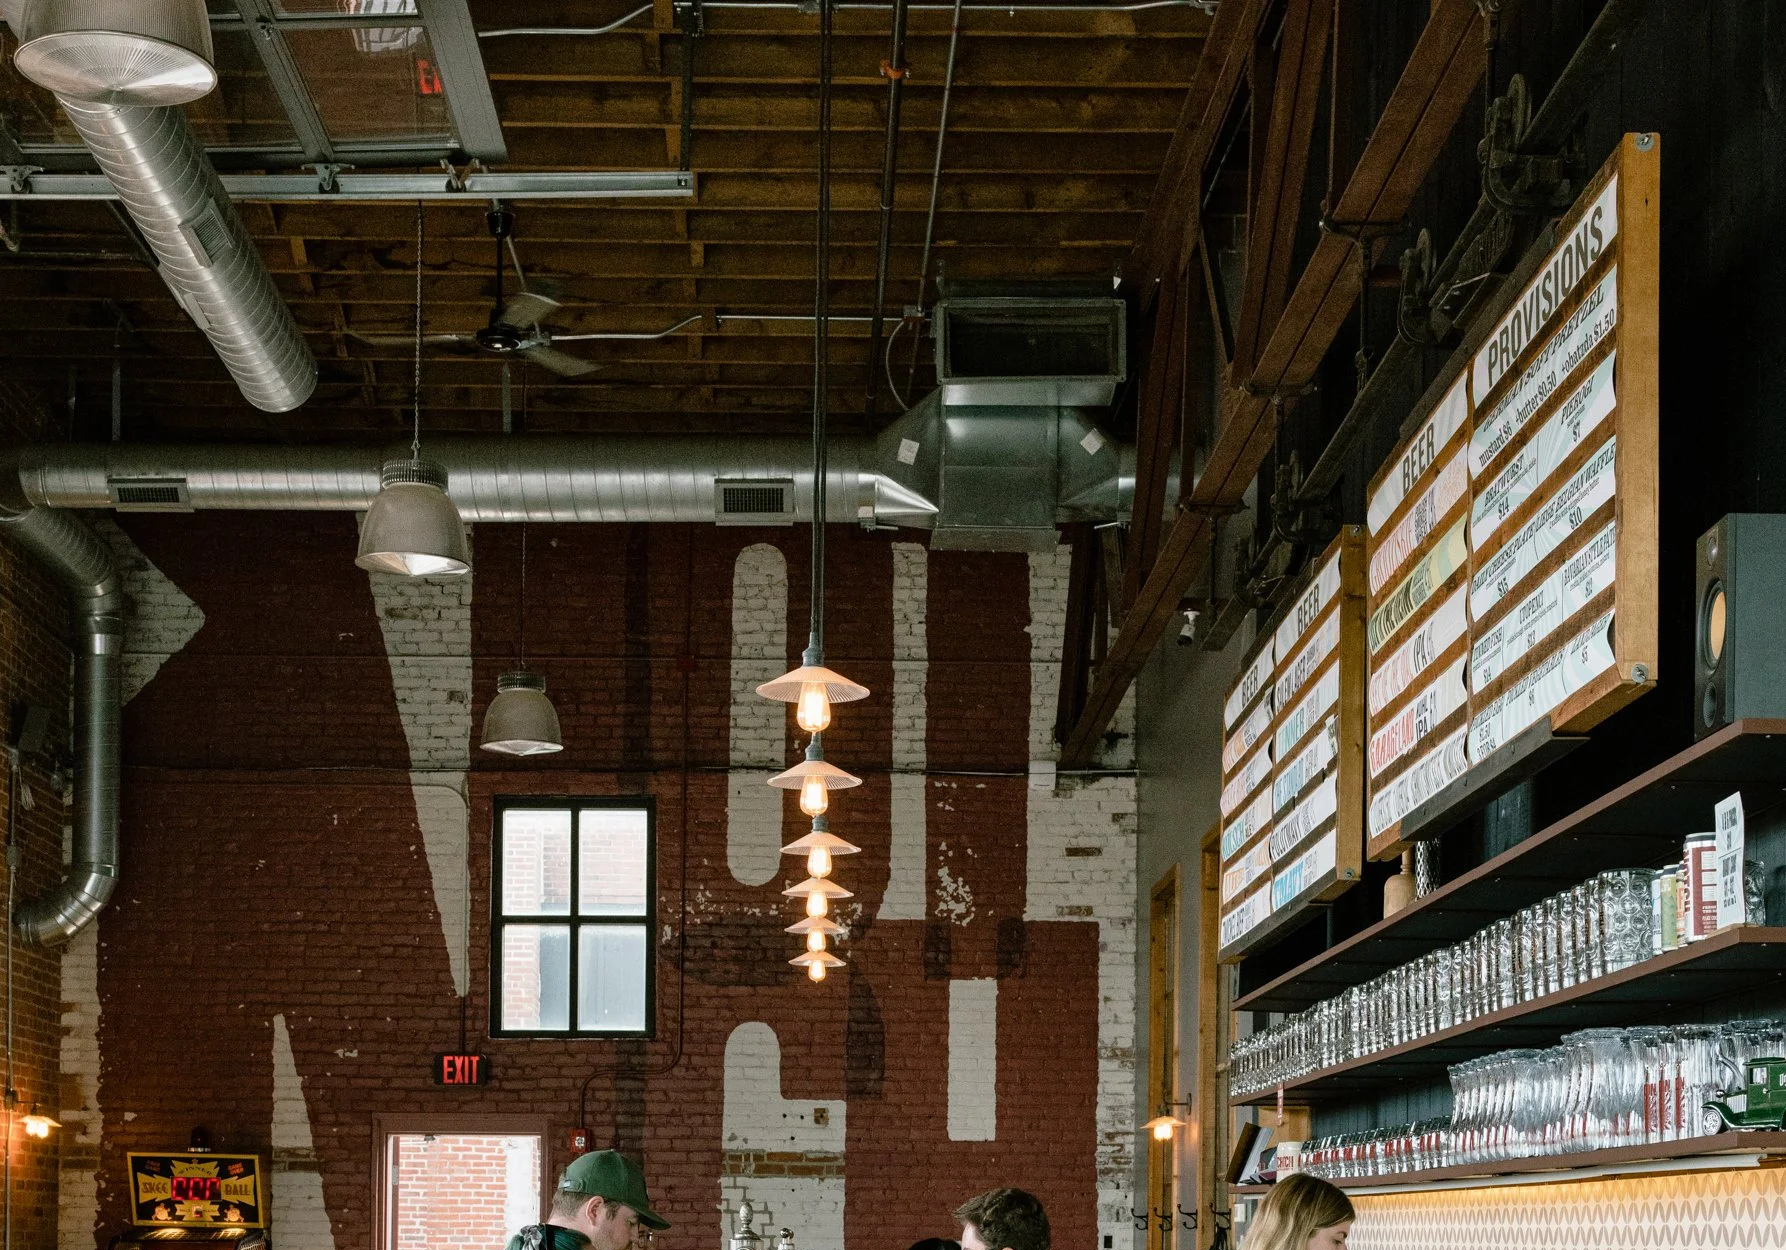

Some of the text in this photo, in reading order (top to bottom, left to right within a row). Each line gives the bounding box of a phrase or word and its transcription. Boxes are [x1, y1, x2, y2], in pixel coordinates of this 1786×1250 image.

[1488, 206, 1603, 389] PROVISIONS
[1550, 284, 1603, 356] PRETZEL
[1479, 428, 1504, 467] mustard
[1503, 421, 1513, 443] $6
[1515, 393, 1540, 425] +butter
[1538, 371, 1557, 402] $0.50
[1593, 308, 1615, 343] $1.50
[1560, 375, 1595, 425] PIEROGI
[1572, 420, 1582, 443] $7
[1402, 422, 1435, 498] BEER
[1484, 454, 1524, 507] BRATWURST
[1498, 496, 1510, 520] $14
[1569, 506, 1582, 530] $10
[1513, 521, 1536, 553] PLATE
[1497, 575, 1509, 597] $15
[1298, 583, 1320, 638] BEER
[1413, 630, 1427, 674] IPA
[1490, 626, 1503, 649] FISH
[1241, 664, 1259, 709] BEER
[1370, 708, 1415, 773] GARAGELAND
[1416, 716, 1428, 741] IPA
[443, 1055, 480, 1084] EXIT
[142, 1181, 168, 1194] SKEE
[224, 1183, 250, 1196] BALL
